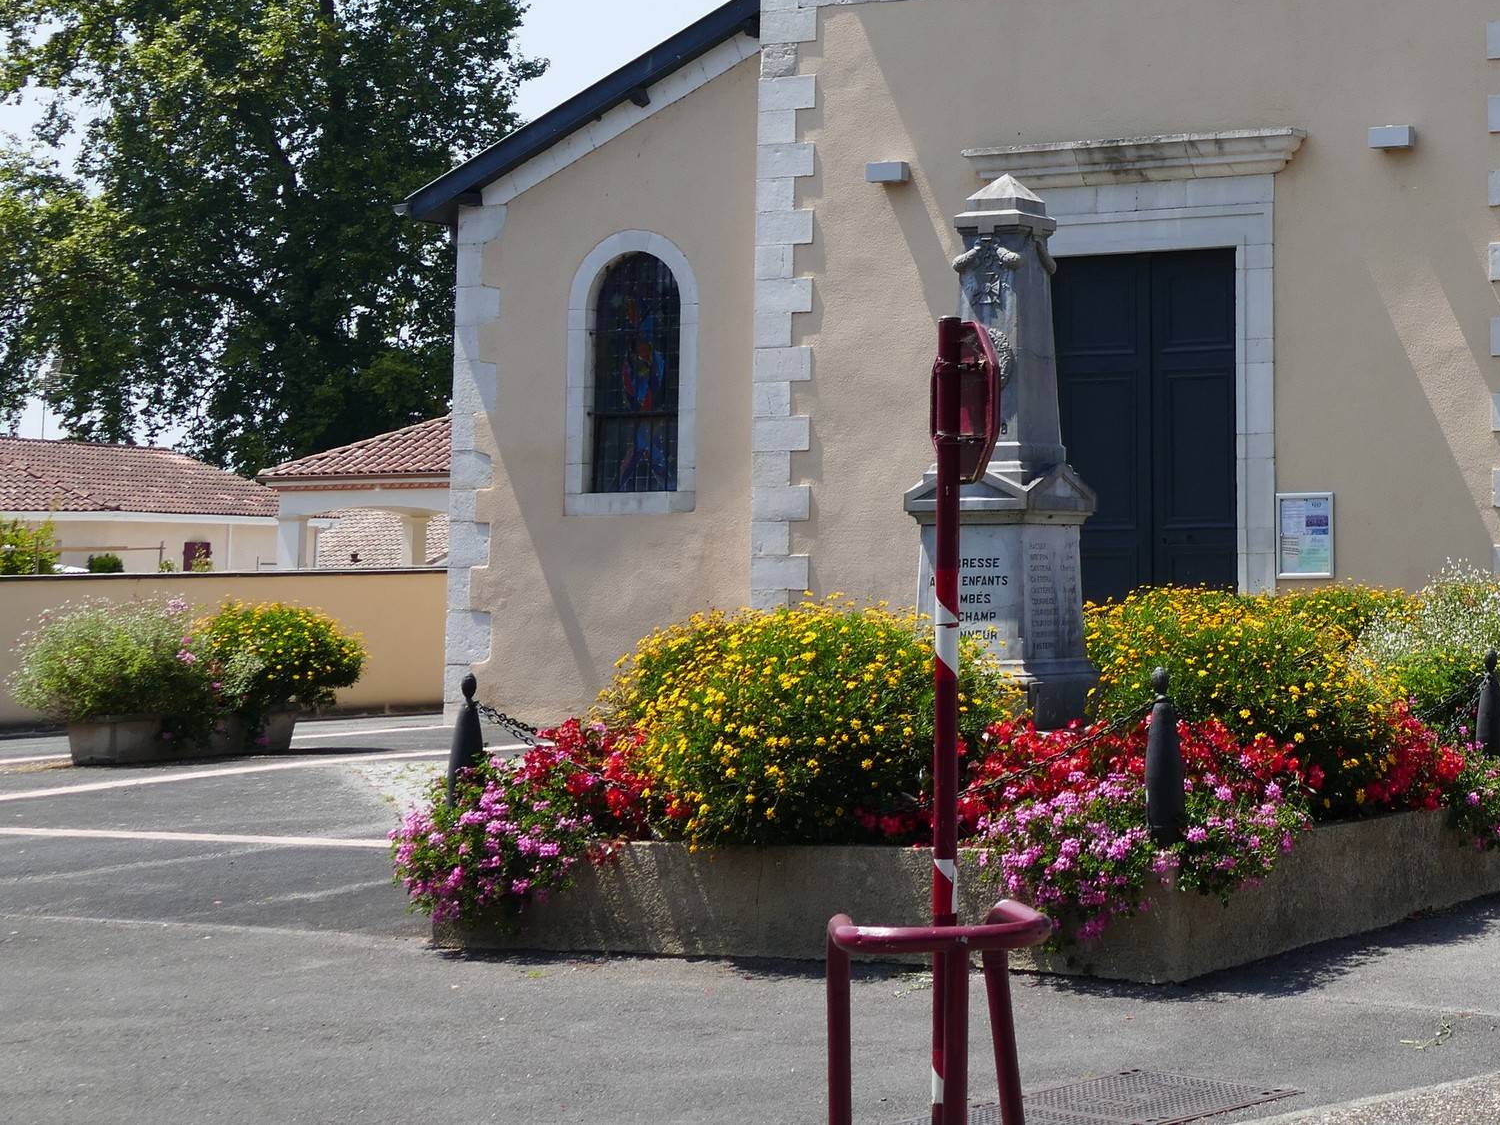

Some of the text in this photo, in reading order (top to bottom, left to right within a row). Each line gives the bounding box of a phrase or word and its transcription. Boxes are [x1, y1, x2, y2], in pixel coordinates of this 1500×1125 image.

[959, 557, 1000, 568] RESSE
[962, 575, 1008, 586] ENFANTS
[960, 591, 991, 604] MBÉS
[959, 611, 996, 622] CHAMP
[960, 630, 998, 640] NNEUR
